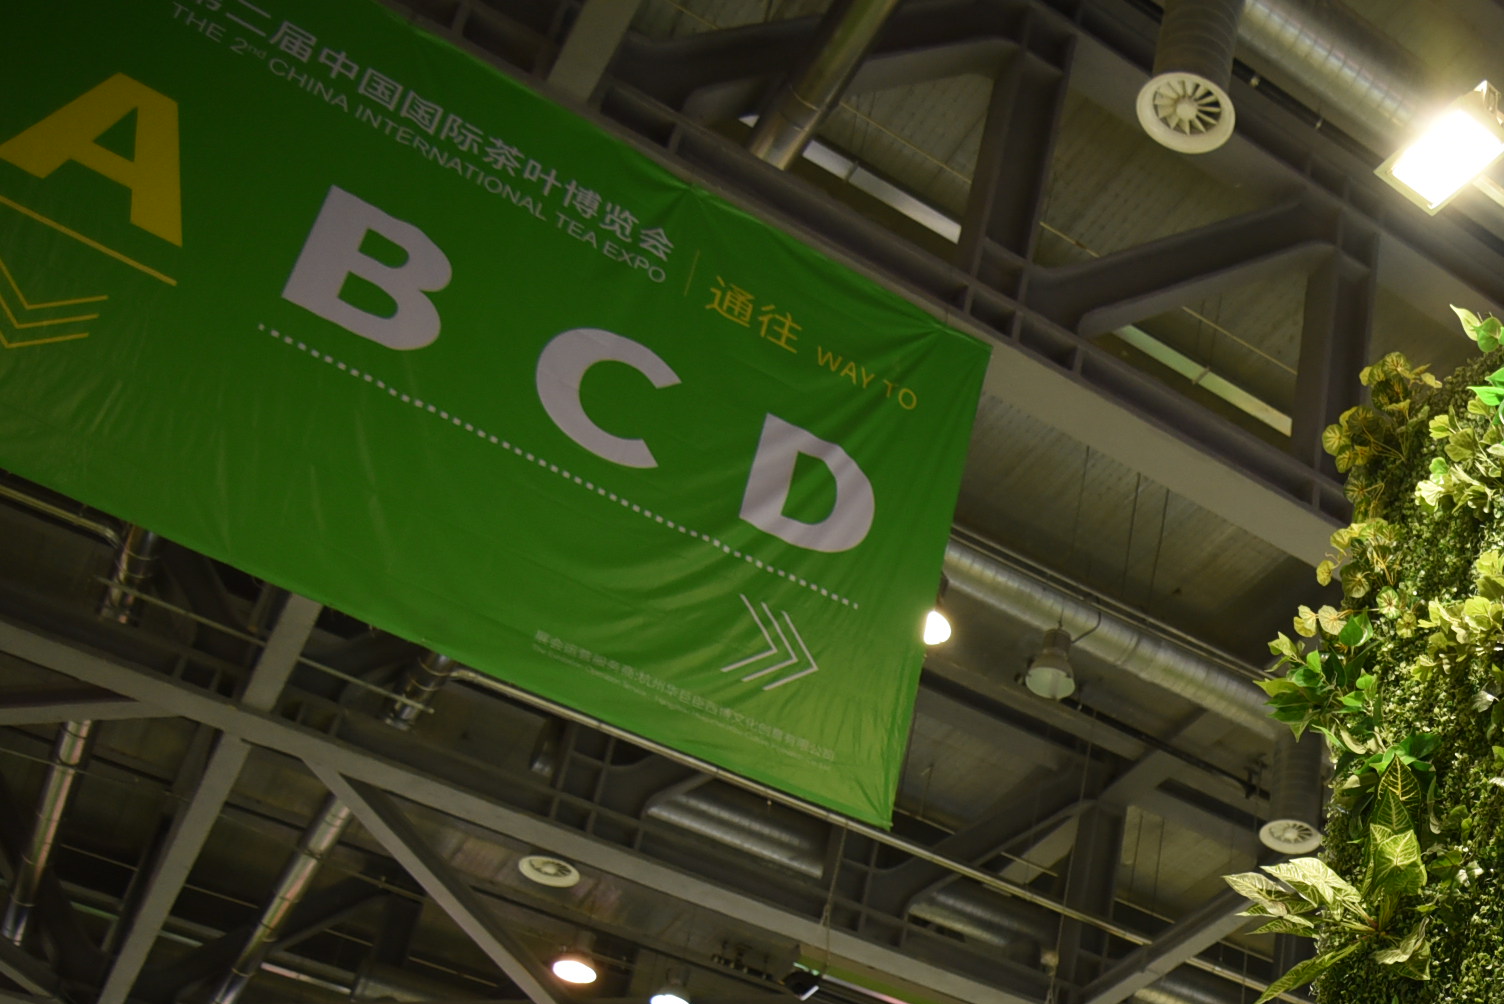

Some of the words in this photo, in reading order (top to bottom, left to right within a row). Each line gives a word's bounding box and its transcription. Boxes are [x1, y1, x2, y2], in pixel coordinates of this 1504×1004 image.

[0, 72, 183, 247] A
[172, 2, 227, 43] THE
[230, 37, 267, 60] 2nd
[269, 57, 349, 113] CHINA
[355, 104, 548, 221] INTERNATIONAL
[556, 211, 598, 249] TEA
[603, 241, 666, 283] EXPO
[197, 0, 675, 262] 二届中国国际茶叶博览会
[281, 184, 453, 351] B
[535, 327, 683, 469] C
[738, 412, 876, 553] D
[705, 275, 803, 354] 通往
[817, 345, 875, 389] WAY
[883, 378, 917, 411] TO
